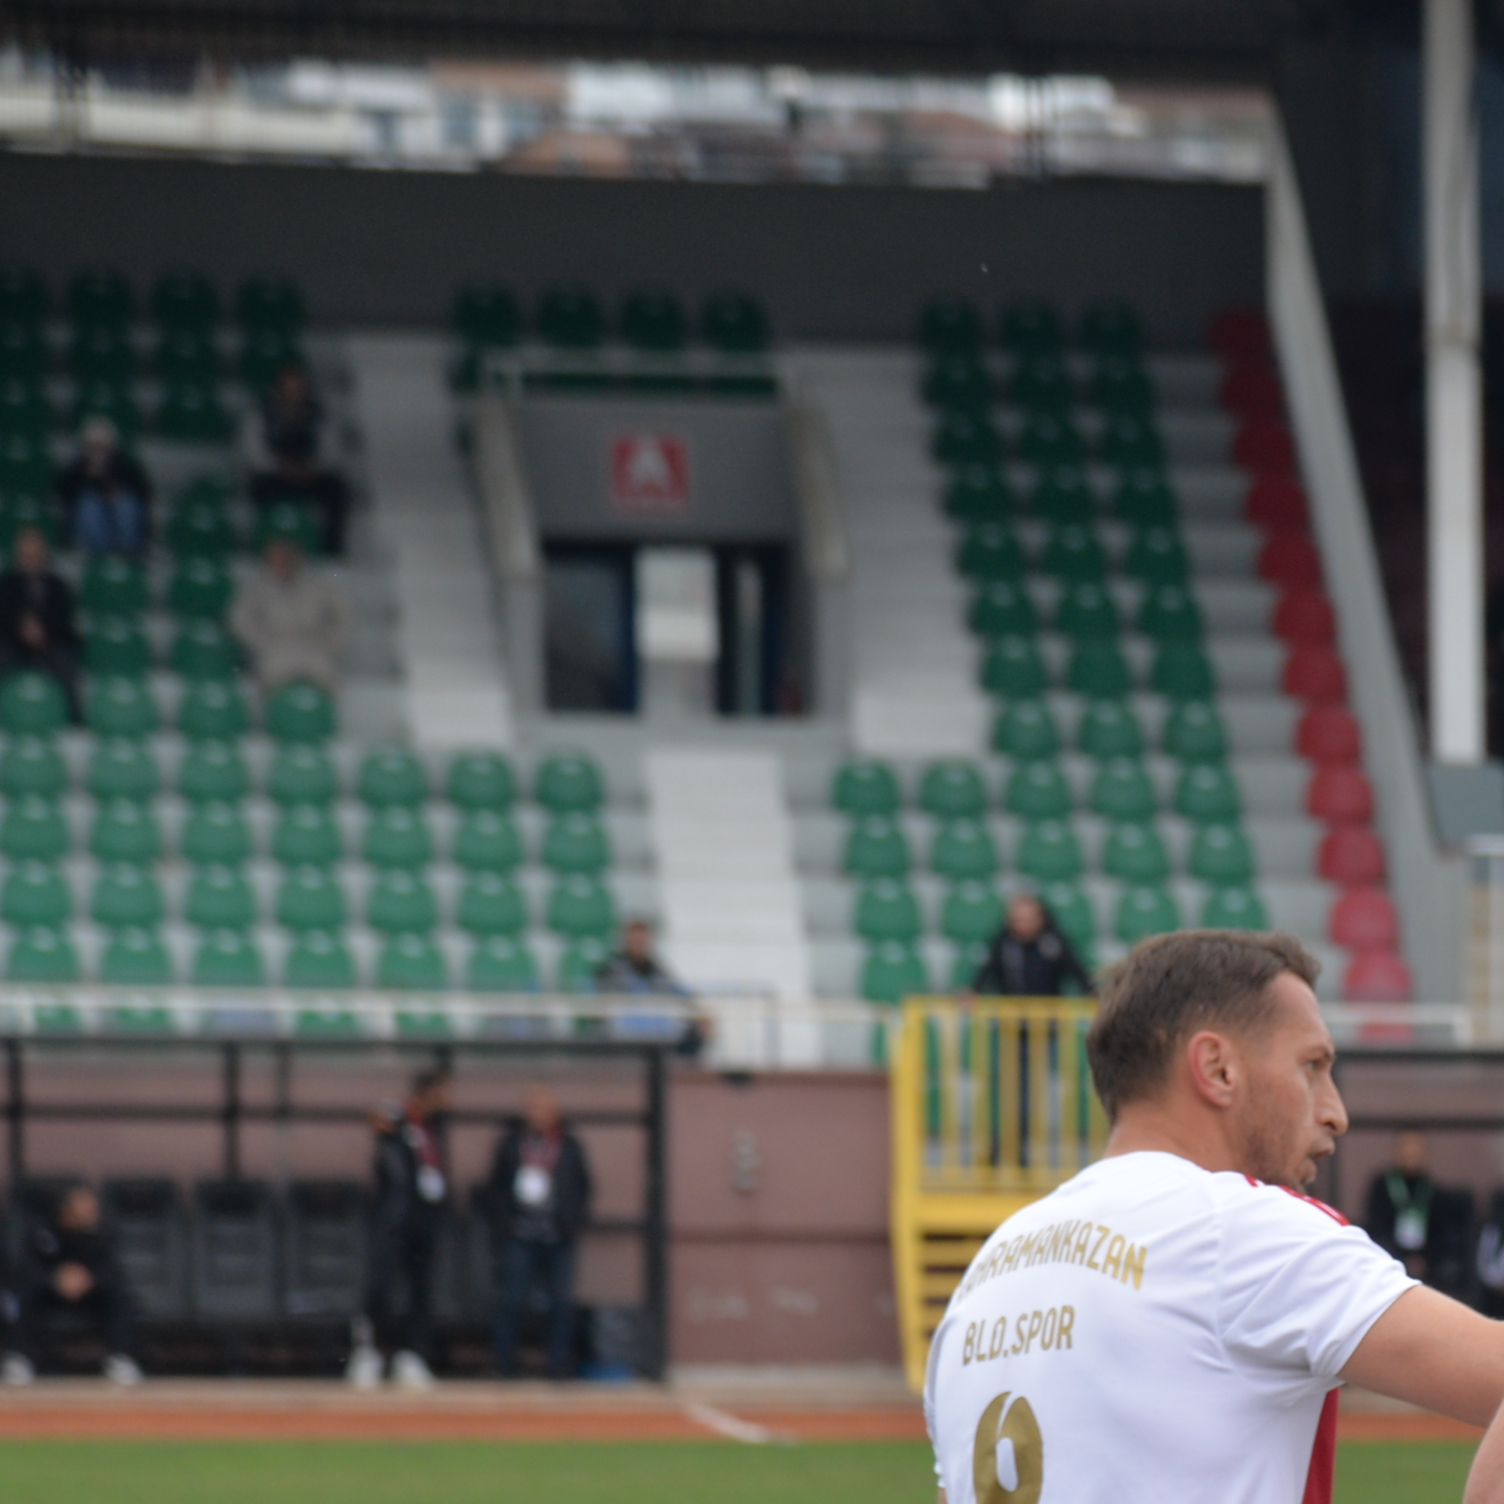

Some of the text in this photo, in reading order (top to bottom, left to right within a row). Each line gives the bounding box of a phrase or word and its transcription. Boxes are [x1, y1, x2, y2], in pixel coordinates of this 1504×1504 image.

[627, 432, 671, 493] A
[956, 1219, 1147, 1299] HRAMANKAZAN
[962, 1305, 1076, 1366] BLD.SPOR
